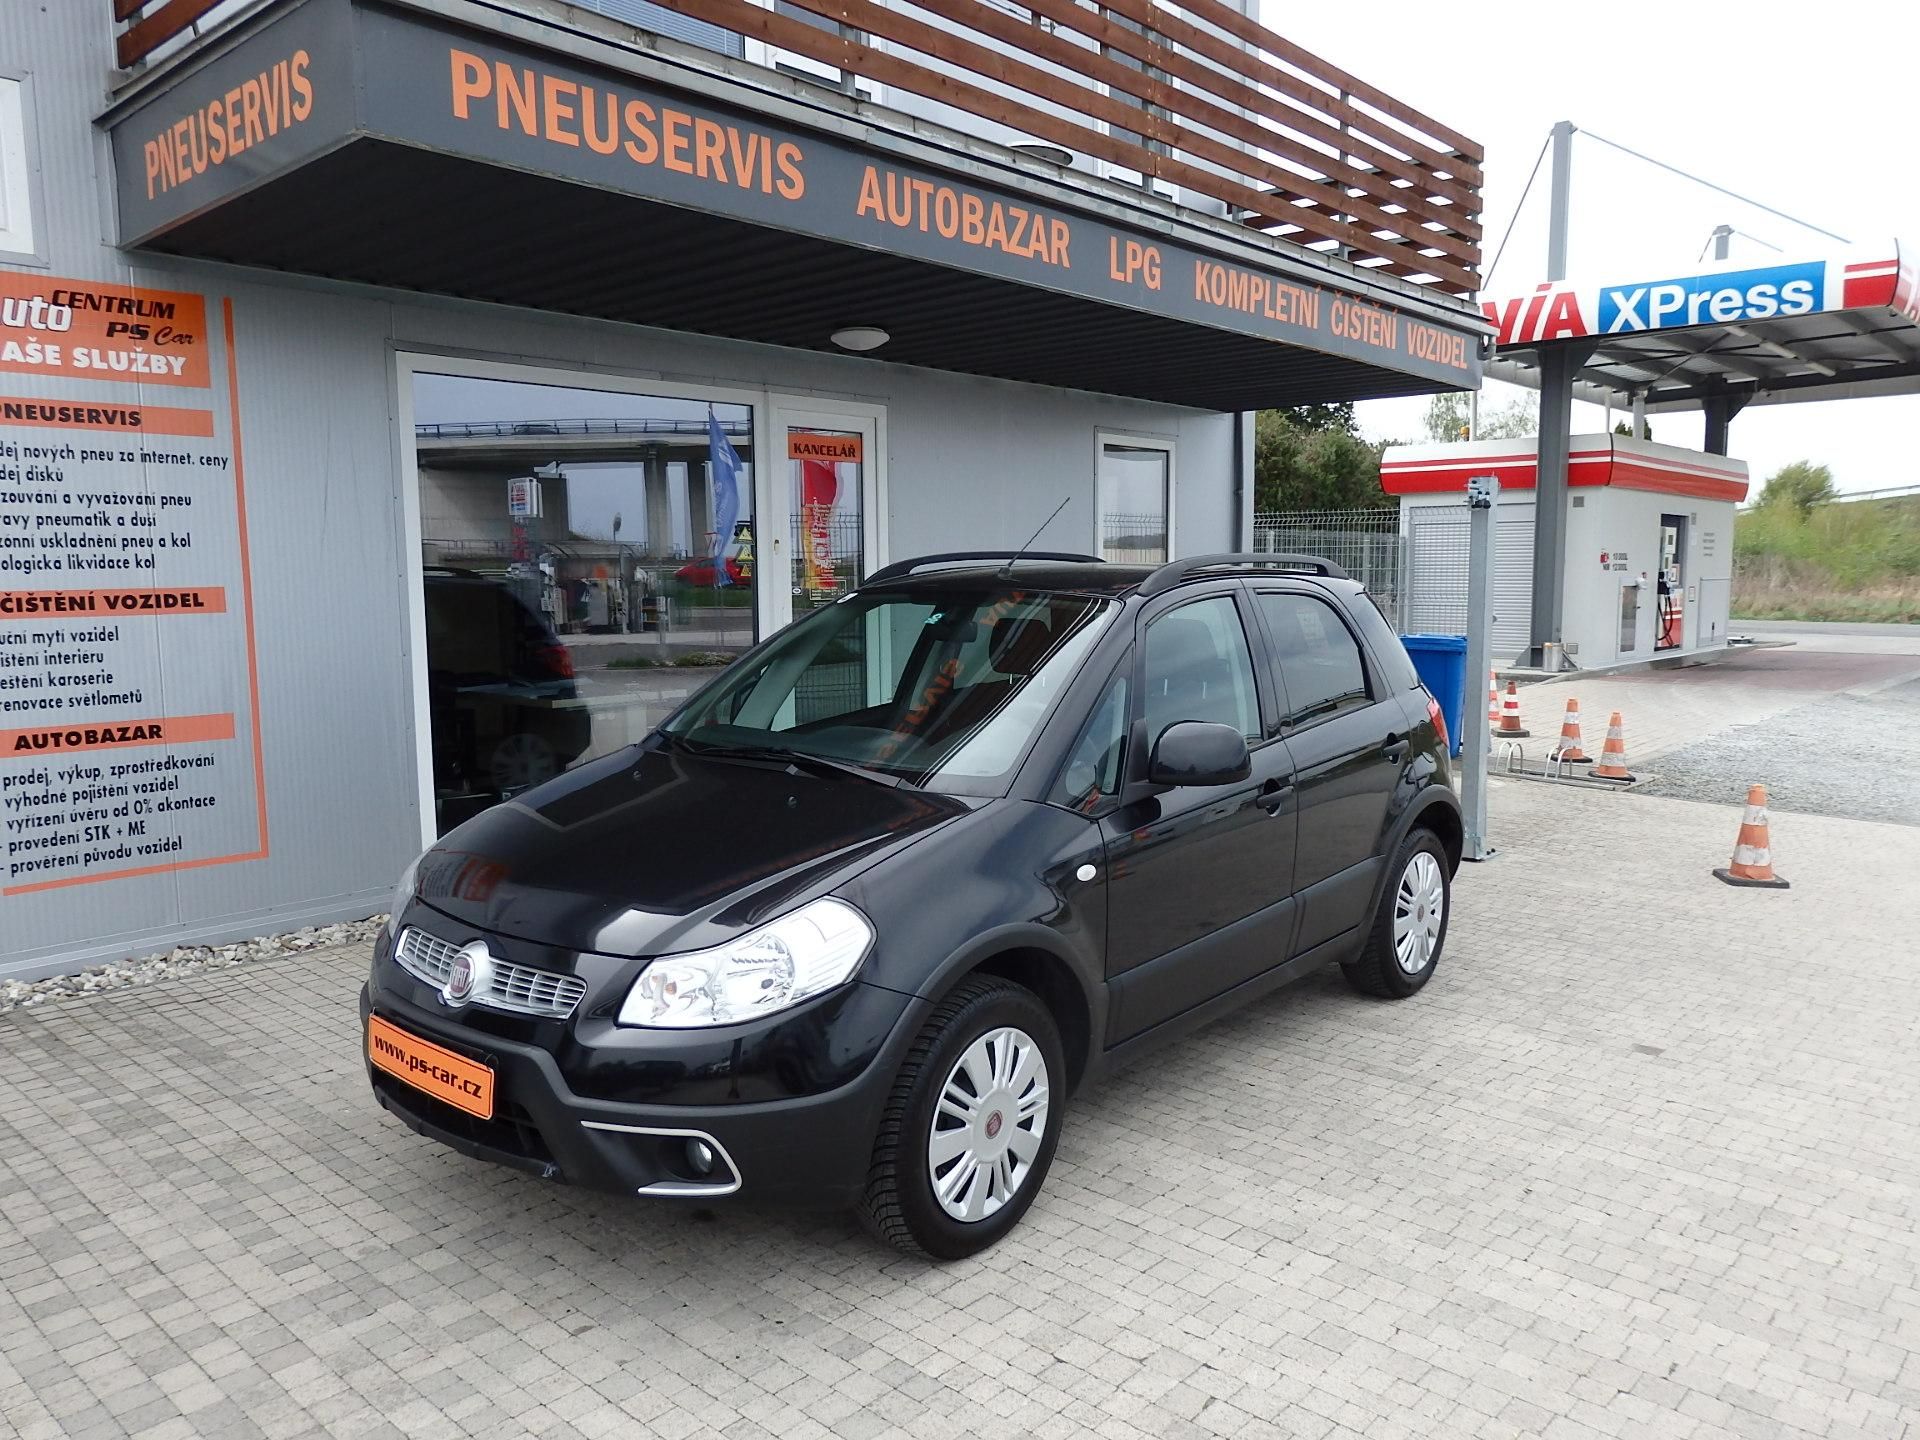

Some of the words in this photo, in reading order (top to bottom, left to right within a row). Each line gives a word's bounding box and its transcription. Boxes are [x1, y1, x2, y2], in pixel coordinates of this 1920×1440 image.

[144, 50, 313, 200] PNEUSERVIS
[450, 48, 806, 201] PNEUSERVIS
[856, 165, 1071, 269] AUTOBAZAR
[1109, 236, 1161, 291] LPG
[1194, 260, 1322, 330] KOMPLETNÍ
[1330, 289, 1399, 350] ČIŠTĚNÍ
[1407, 322, 1468, 370] VOZIDEL
[0, 295, 73, 332] uto
[52, 290, 176, 320] CENTRUM
[1482, 283, 1588, 345] VIA
[1609, 278, 1813, 332] XPress
[106, 321, 151, 341] PS
[154, 326, 195, 346] Car
[2, 336, 62, 366] AŠE
[72, 346, 187, 376] SLUŽBY
[0, 403, 142, 427] NEUSERVIS
[23, 444, 75, 463] nových
[81, 449, 114, 464] pneu
[119, 451, 135, 462] za
[140, 447, 195, 465] internet.
[200, 455, 228, 470] ceny
[793, 441, 857, 458] KANCELÁŘ
[26, 465, 64, 481] disků
[63, 493, 71, 504] a
[76, 491, 156, 508] vyvažování
[160, 495, 192, 509] pneu
[0, 515, 30, 530] avy
[36, 511, 111, 530] pneumatik
[117, 515, 125, 526] a
[131, 511, 156, 526] duší
[40, 531, 117, 548] uskladnění
[121, 536, 154, 551] pneu
[158, 537, 166, 547] a
[171, 532, 191, 547] kol
[67, 553, 130, 570] likvidace
[135, 553, 155, 569] kol
[0, 591, 96, 613] ČIŠTĚNÍ
[103, 593, 204, 609] VOZIDEL
[70, 625, 119, 642] vozidel
[44, 648, 104, 665] interiéru
[48, 668, 114, 687] karoserie
[68, 689, 142, 708] světlometů
[14, 724, 163, 750] AUTOBAZAR
[3, 767, 53, 791] prodej,
[58, 763, 105, 784] výkup,
[110, 753, 215, 779] zprostředkování
[5, 788, 67, 812] výhodné
[73, 781, 128, 805] pojištění
[133, 775, 179, 794] vozidel
[7, 810, 65, 834] vyřízení
[70, 808, 108, 824] úvěru
[113, 801, 129, 818] od
[134, 798, 153, 815] 0%
[157, 796, 216, 812] akontace
[9, 830, 80, 857] provedení
[85, 824, 111, 843] STK
[128, 820, 146, 837] ME
[11, 851, 79, 878] prověření
[84, 843, 132, 867] původu
[137, 835, 183, 856] vozidel
[374, 1035, 482, 1099] www.ps-car.cz
